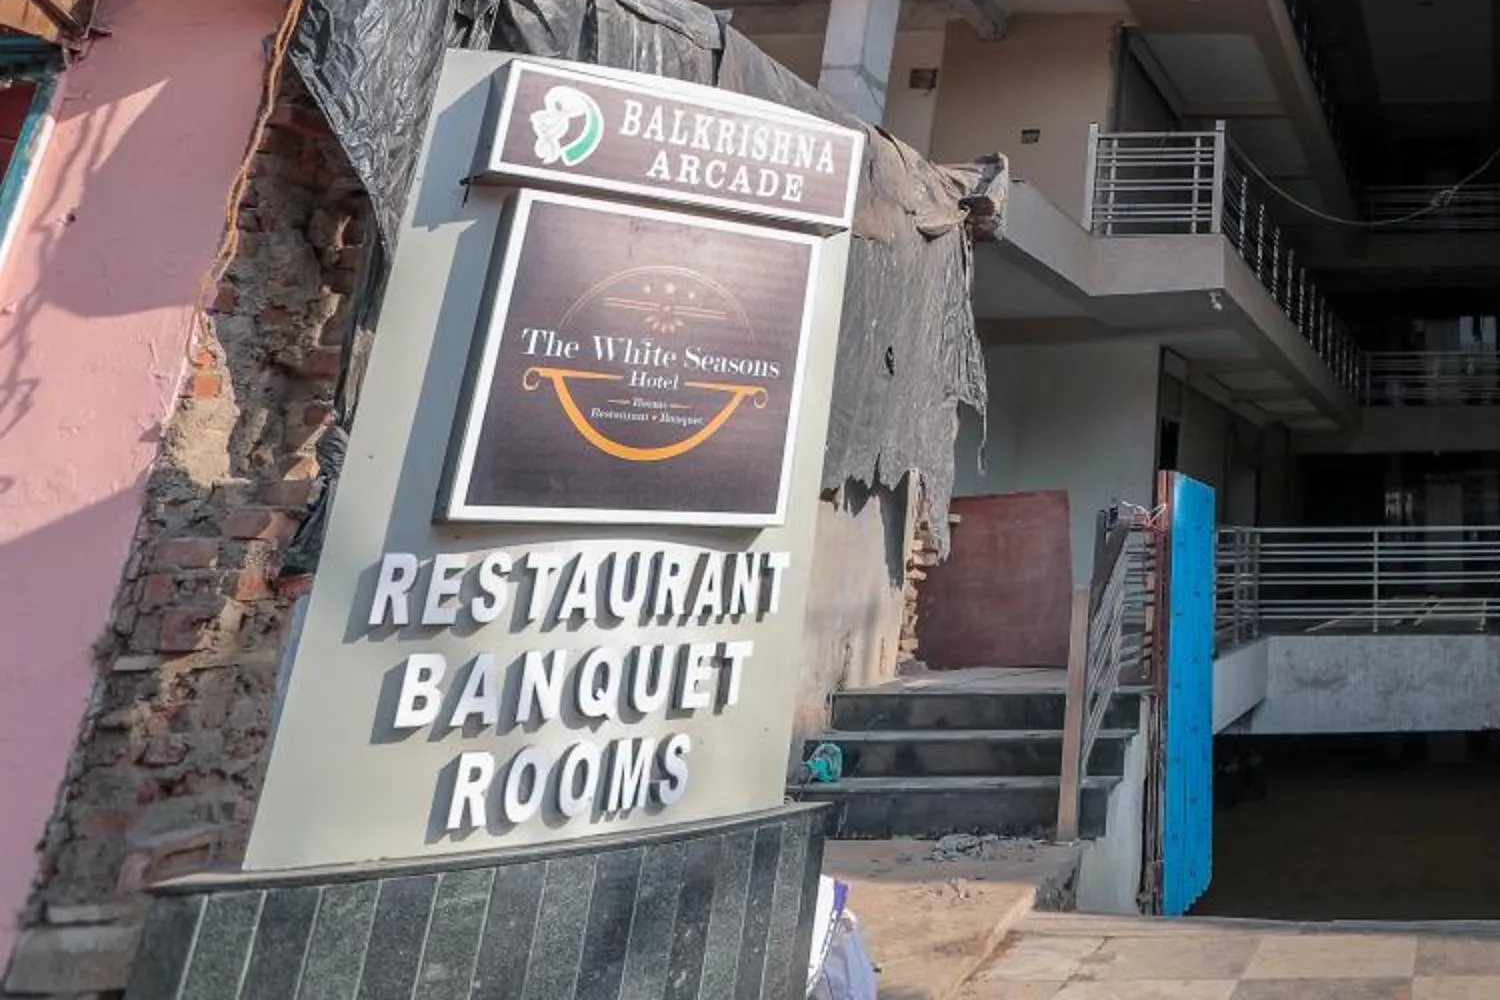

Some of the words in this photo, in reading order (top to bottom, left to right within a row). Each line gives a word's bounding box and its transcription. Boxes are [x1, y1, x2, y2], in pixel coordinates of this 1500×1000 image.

[619, 99, 835, 175] BALKRISHNA
[645, 151, 805, 203] ARCADE
[521, 327, 579, 359] The
[592, 335, 676, 369] White
[683, 346, 781, 379] Seasons
[629, 370, 680, 391] Hotel
[368, 551, 790, 626] RESTAURANT
[393, 640, 753, 730] BANQUET
[446, 733, 693, 831] ROOMS
